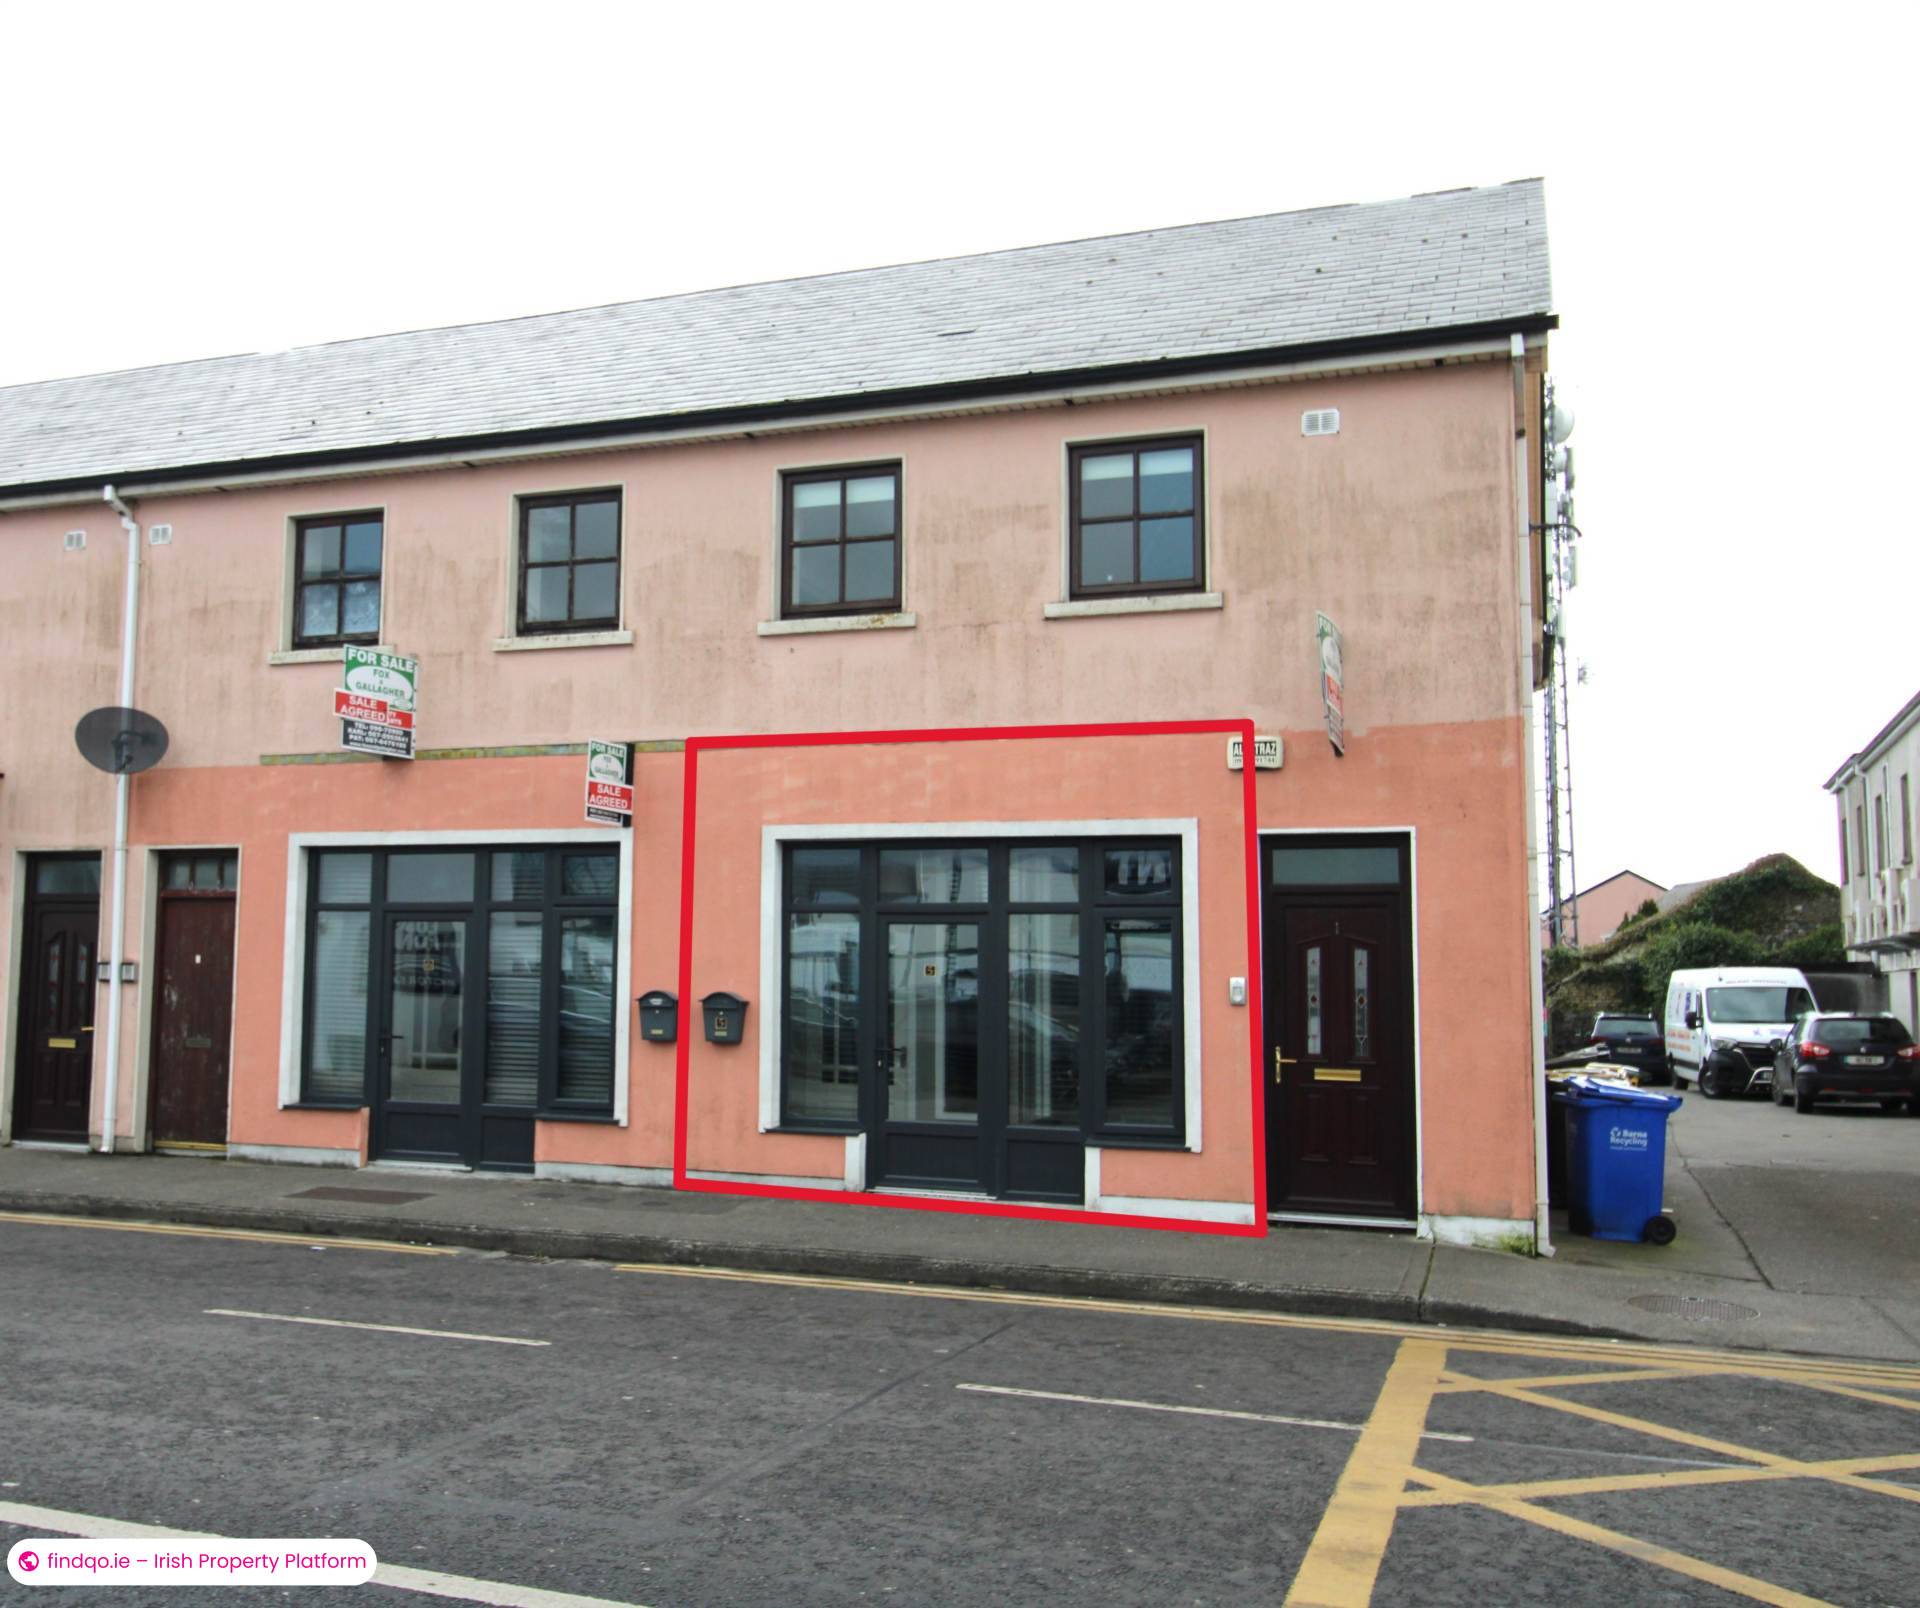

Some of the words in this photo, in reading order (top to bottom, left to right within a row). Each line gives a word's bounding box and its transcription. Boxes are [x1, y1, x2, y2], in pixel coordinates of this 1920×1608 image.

[348, 649, 377, 665] FOR
[381, 656, 414, 672] SALE
[373, 669, 390, 679] FOX
[356, 682, 404, 697] GALLAGHER
[349, 696, 378, 709] SALE
[340, 706, 386, 722] AGREED
[592, 743, 606, 752] FOR
[608, 746, 624, 756] SALE
[1234, 742, 1276, 756] ALTRAZ
[597, 784, 621, 797] SALE
[590, 794, 628, 808] AGREED
[1610, 1136, 1648, 1147] Recycling
